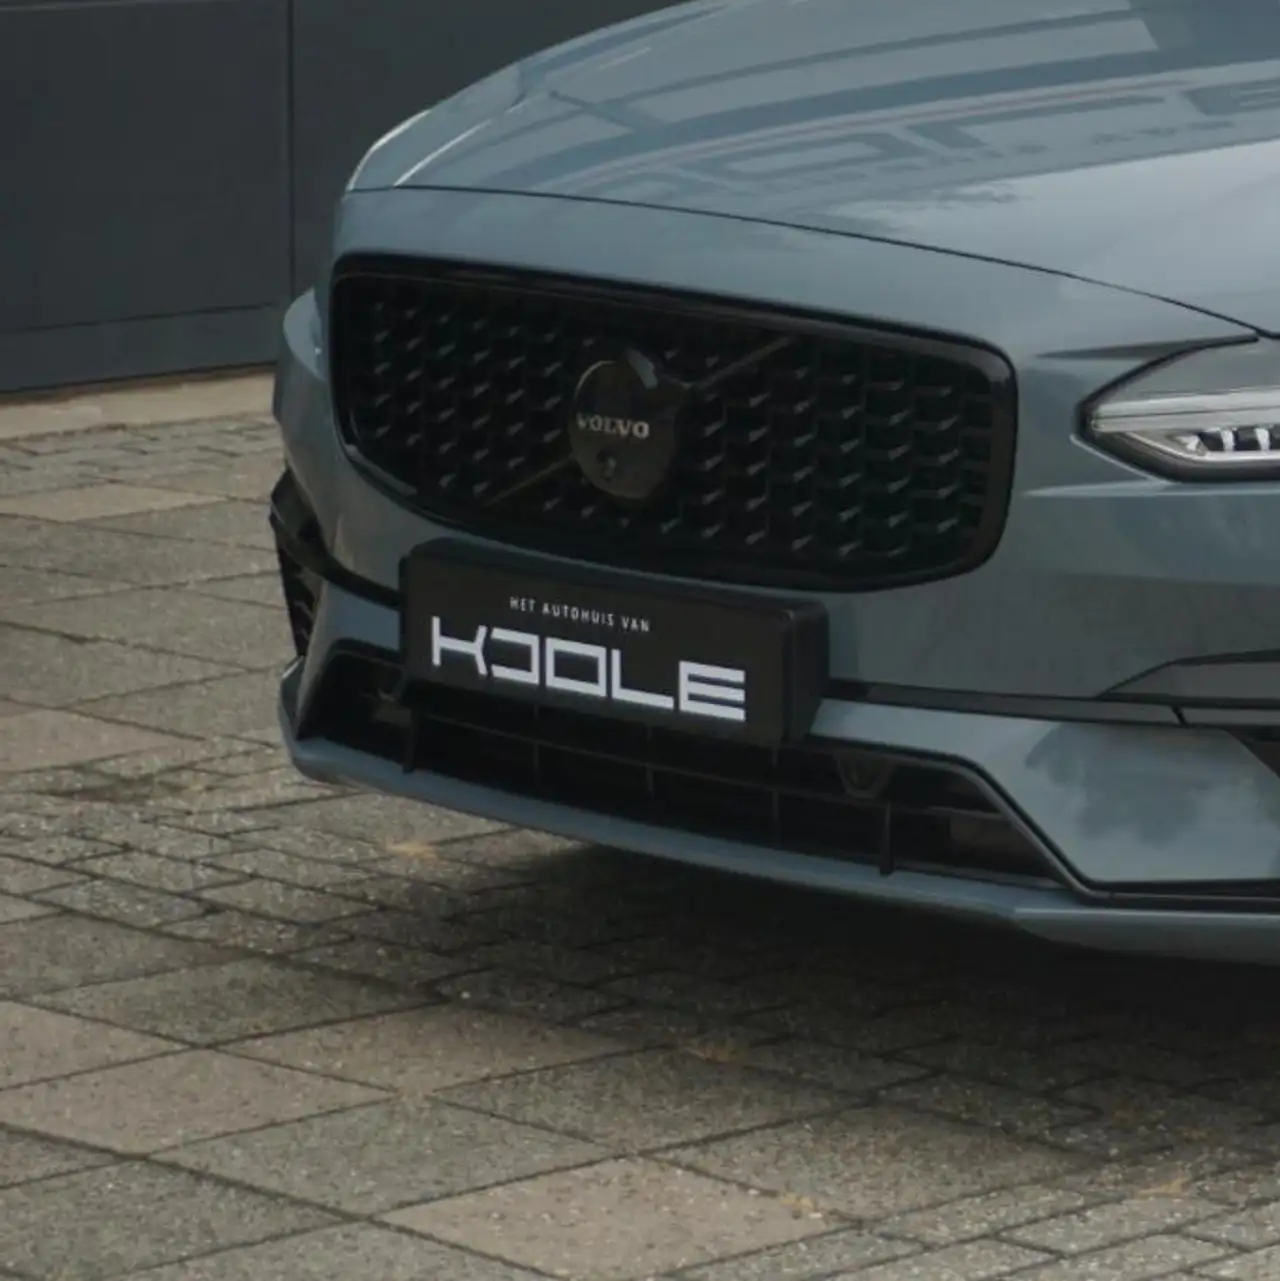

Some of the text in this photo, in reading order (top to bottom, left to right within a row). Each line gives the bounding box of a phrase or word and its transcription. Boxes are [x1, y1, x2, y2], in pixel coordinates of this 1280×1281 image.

[575, 412, 650, 440] VOLVO
[509, 595, 650, 633] HET AUTOHUIS VAN
[431, 616, 746, 721] KOOLE
